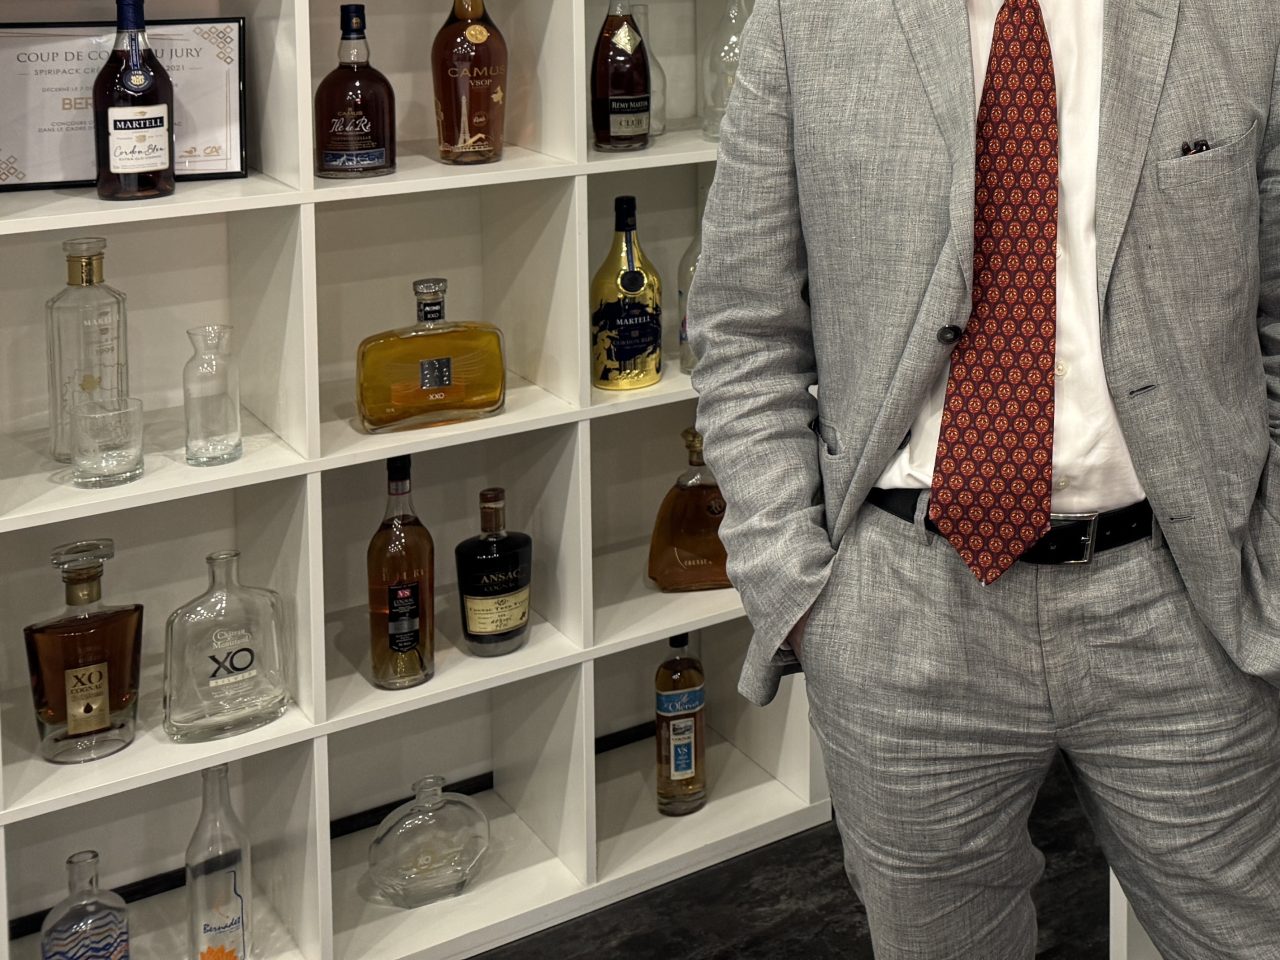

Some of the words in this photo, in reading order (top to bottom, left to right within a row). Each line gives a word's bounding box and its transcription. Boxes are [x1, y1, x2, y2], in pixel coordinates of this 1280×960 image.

[16, 51, 60, 63] COUP
[64, 51, 84, 61] DE
[170, 47, 203, 59] JURY
[34, 67, 81, 76] SPIRIPACK
[165, 64, 185, 72] 2021
[447, 64, 506, 78] CAMUS
[115, 118, 163, 130] MARTELL
[481, 568, 521, 584] ANSAC
[208, 647, 255, 679] XO
[72, 670, 103, 689] XO
